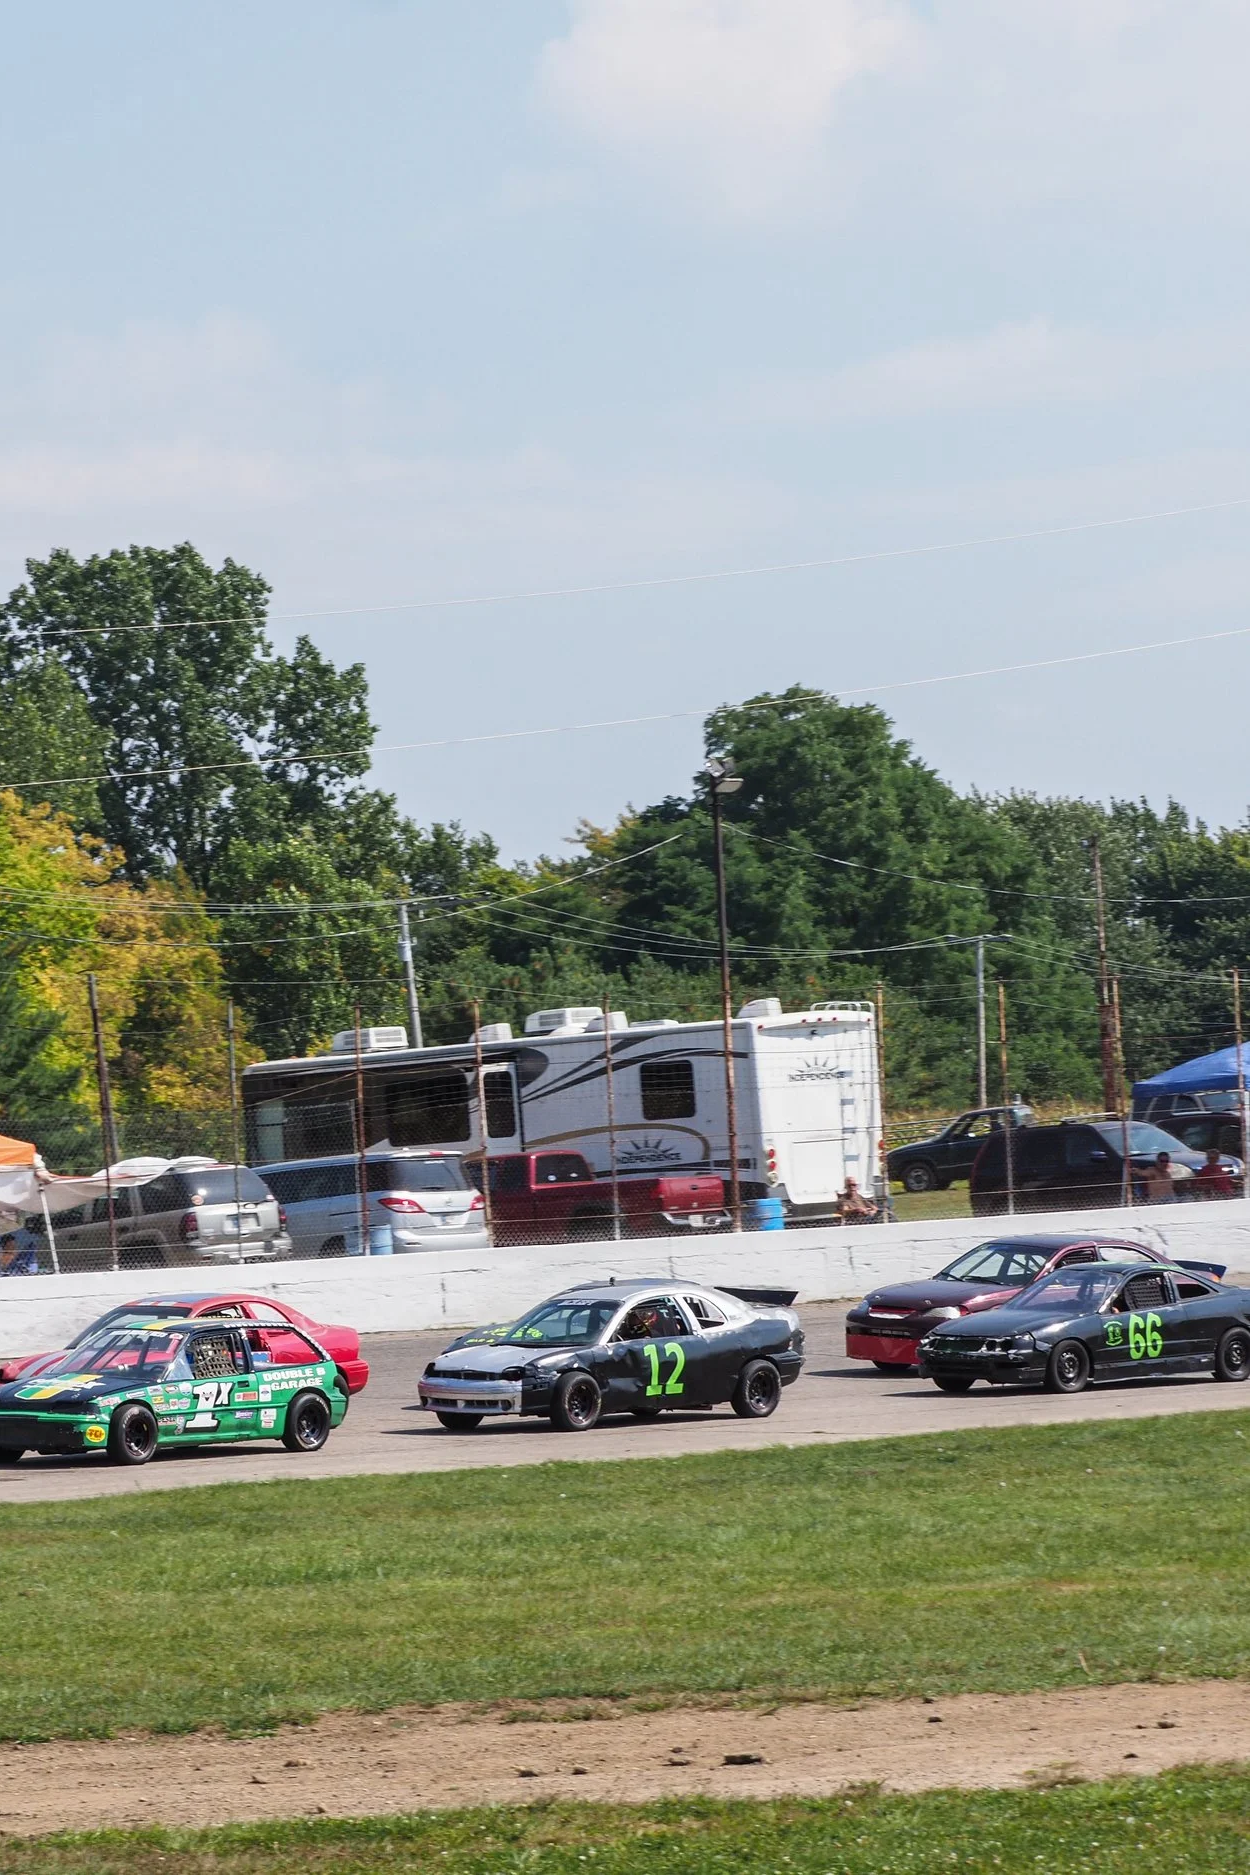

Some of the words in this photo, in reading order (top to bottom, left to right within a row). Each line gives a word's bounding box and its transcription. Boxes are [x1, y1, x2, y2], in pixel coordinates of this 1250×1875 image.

[1129, 1312, 1163, 1360] 66
[262, 1368, 314, 1382] DOUBLE
[271, 1377, 324, 1391] GARAGE
[643, 1342, 685, 1396] 12
